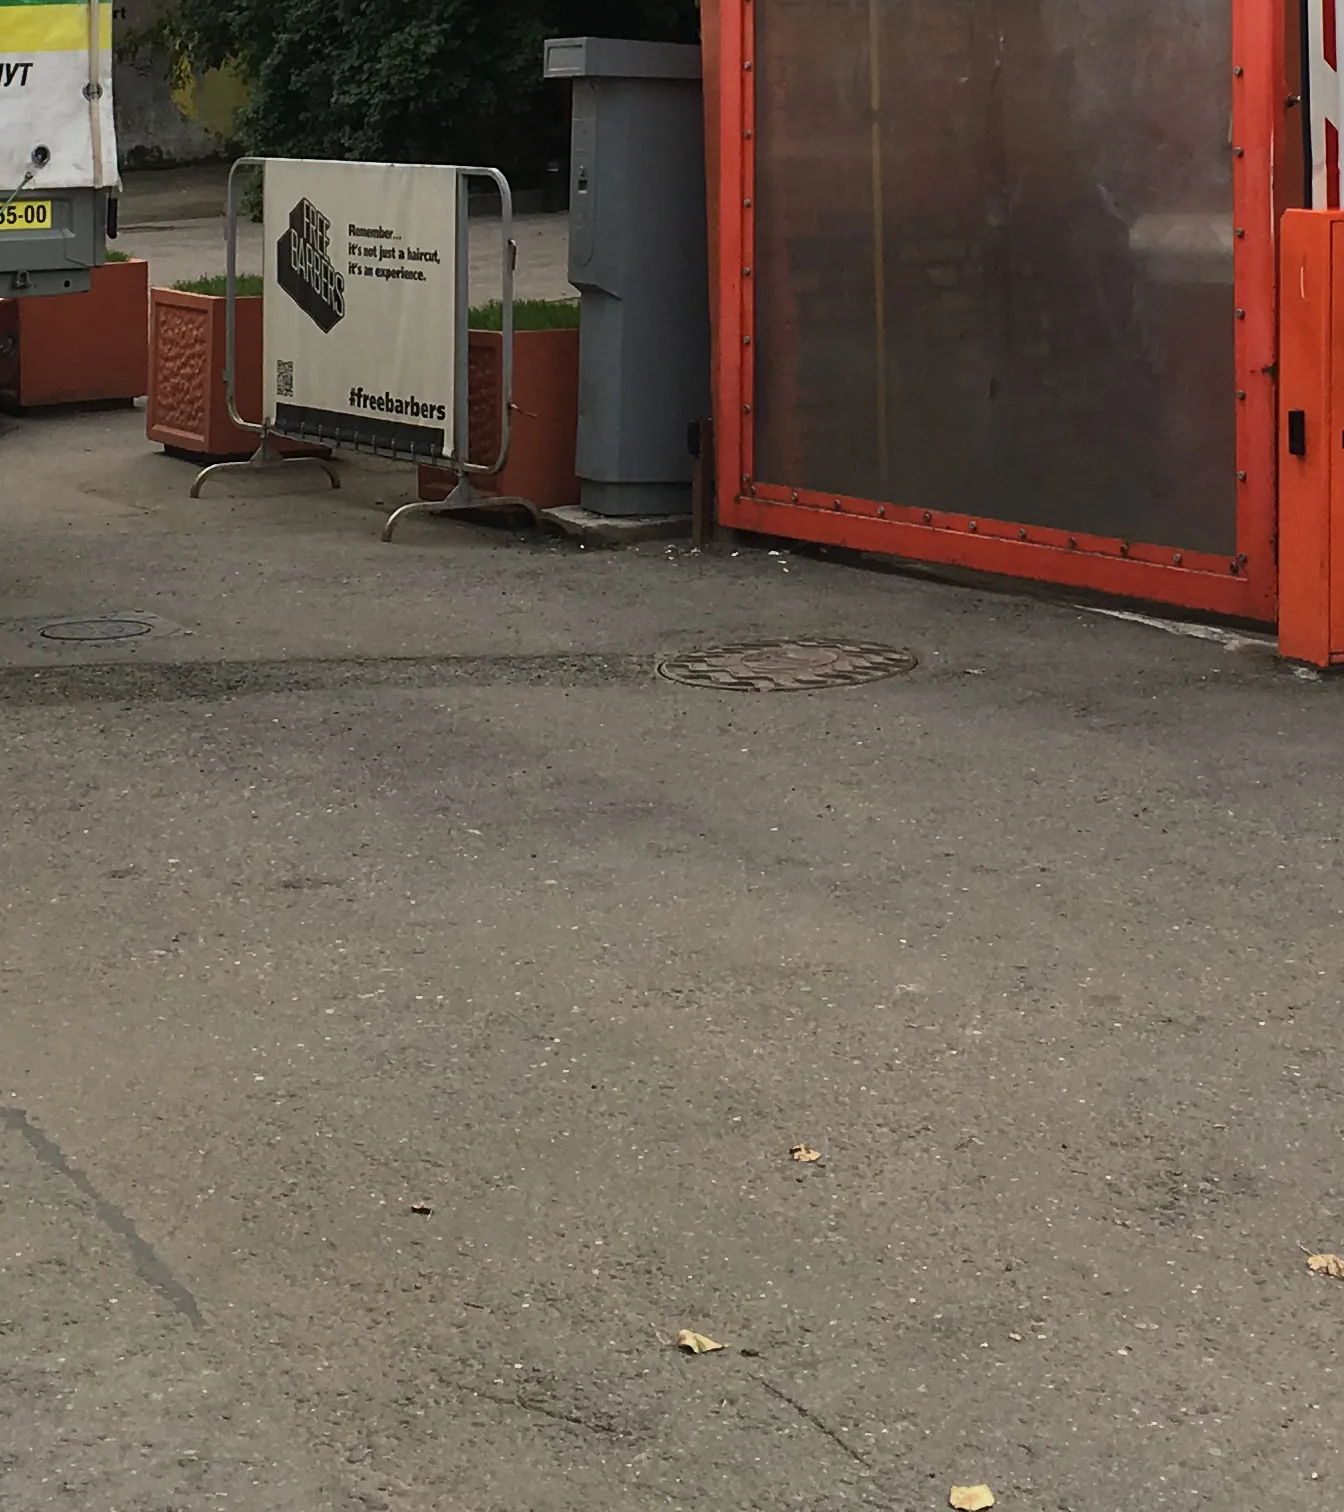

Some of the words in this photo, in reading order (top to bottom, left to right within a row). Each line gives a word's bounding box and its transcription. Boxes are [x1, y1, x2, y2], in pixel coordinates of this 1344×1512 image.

[303, 199, 331, 263] FREE
[348, 262, 362, 275] it's
[364, 266, 373, 277] an
[375, 266, 427, 282] experience.
[363, 246, 377, 258] not
[378, 245, 396, 261] just
[398, 249, 405, 260] a
[407, 247, 441, 265] haircut,
[290, 228, 346, 317] BARBERS
[349, 387, 446, 421] #freebarbers
